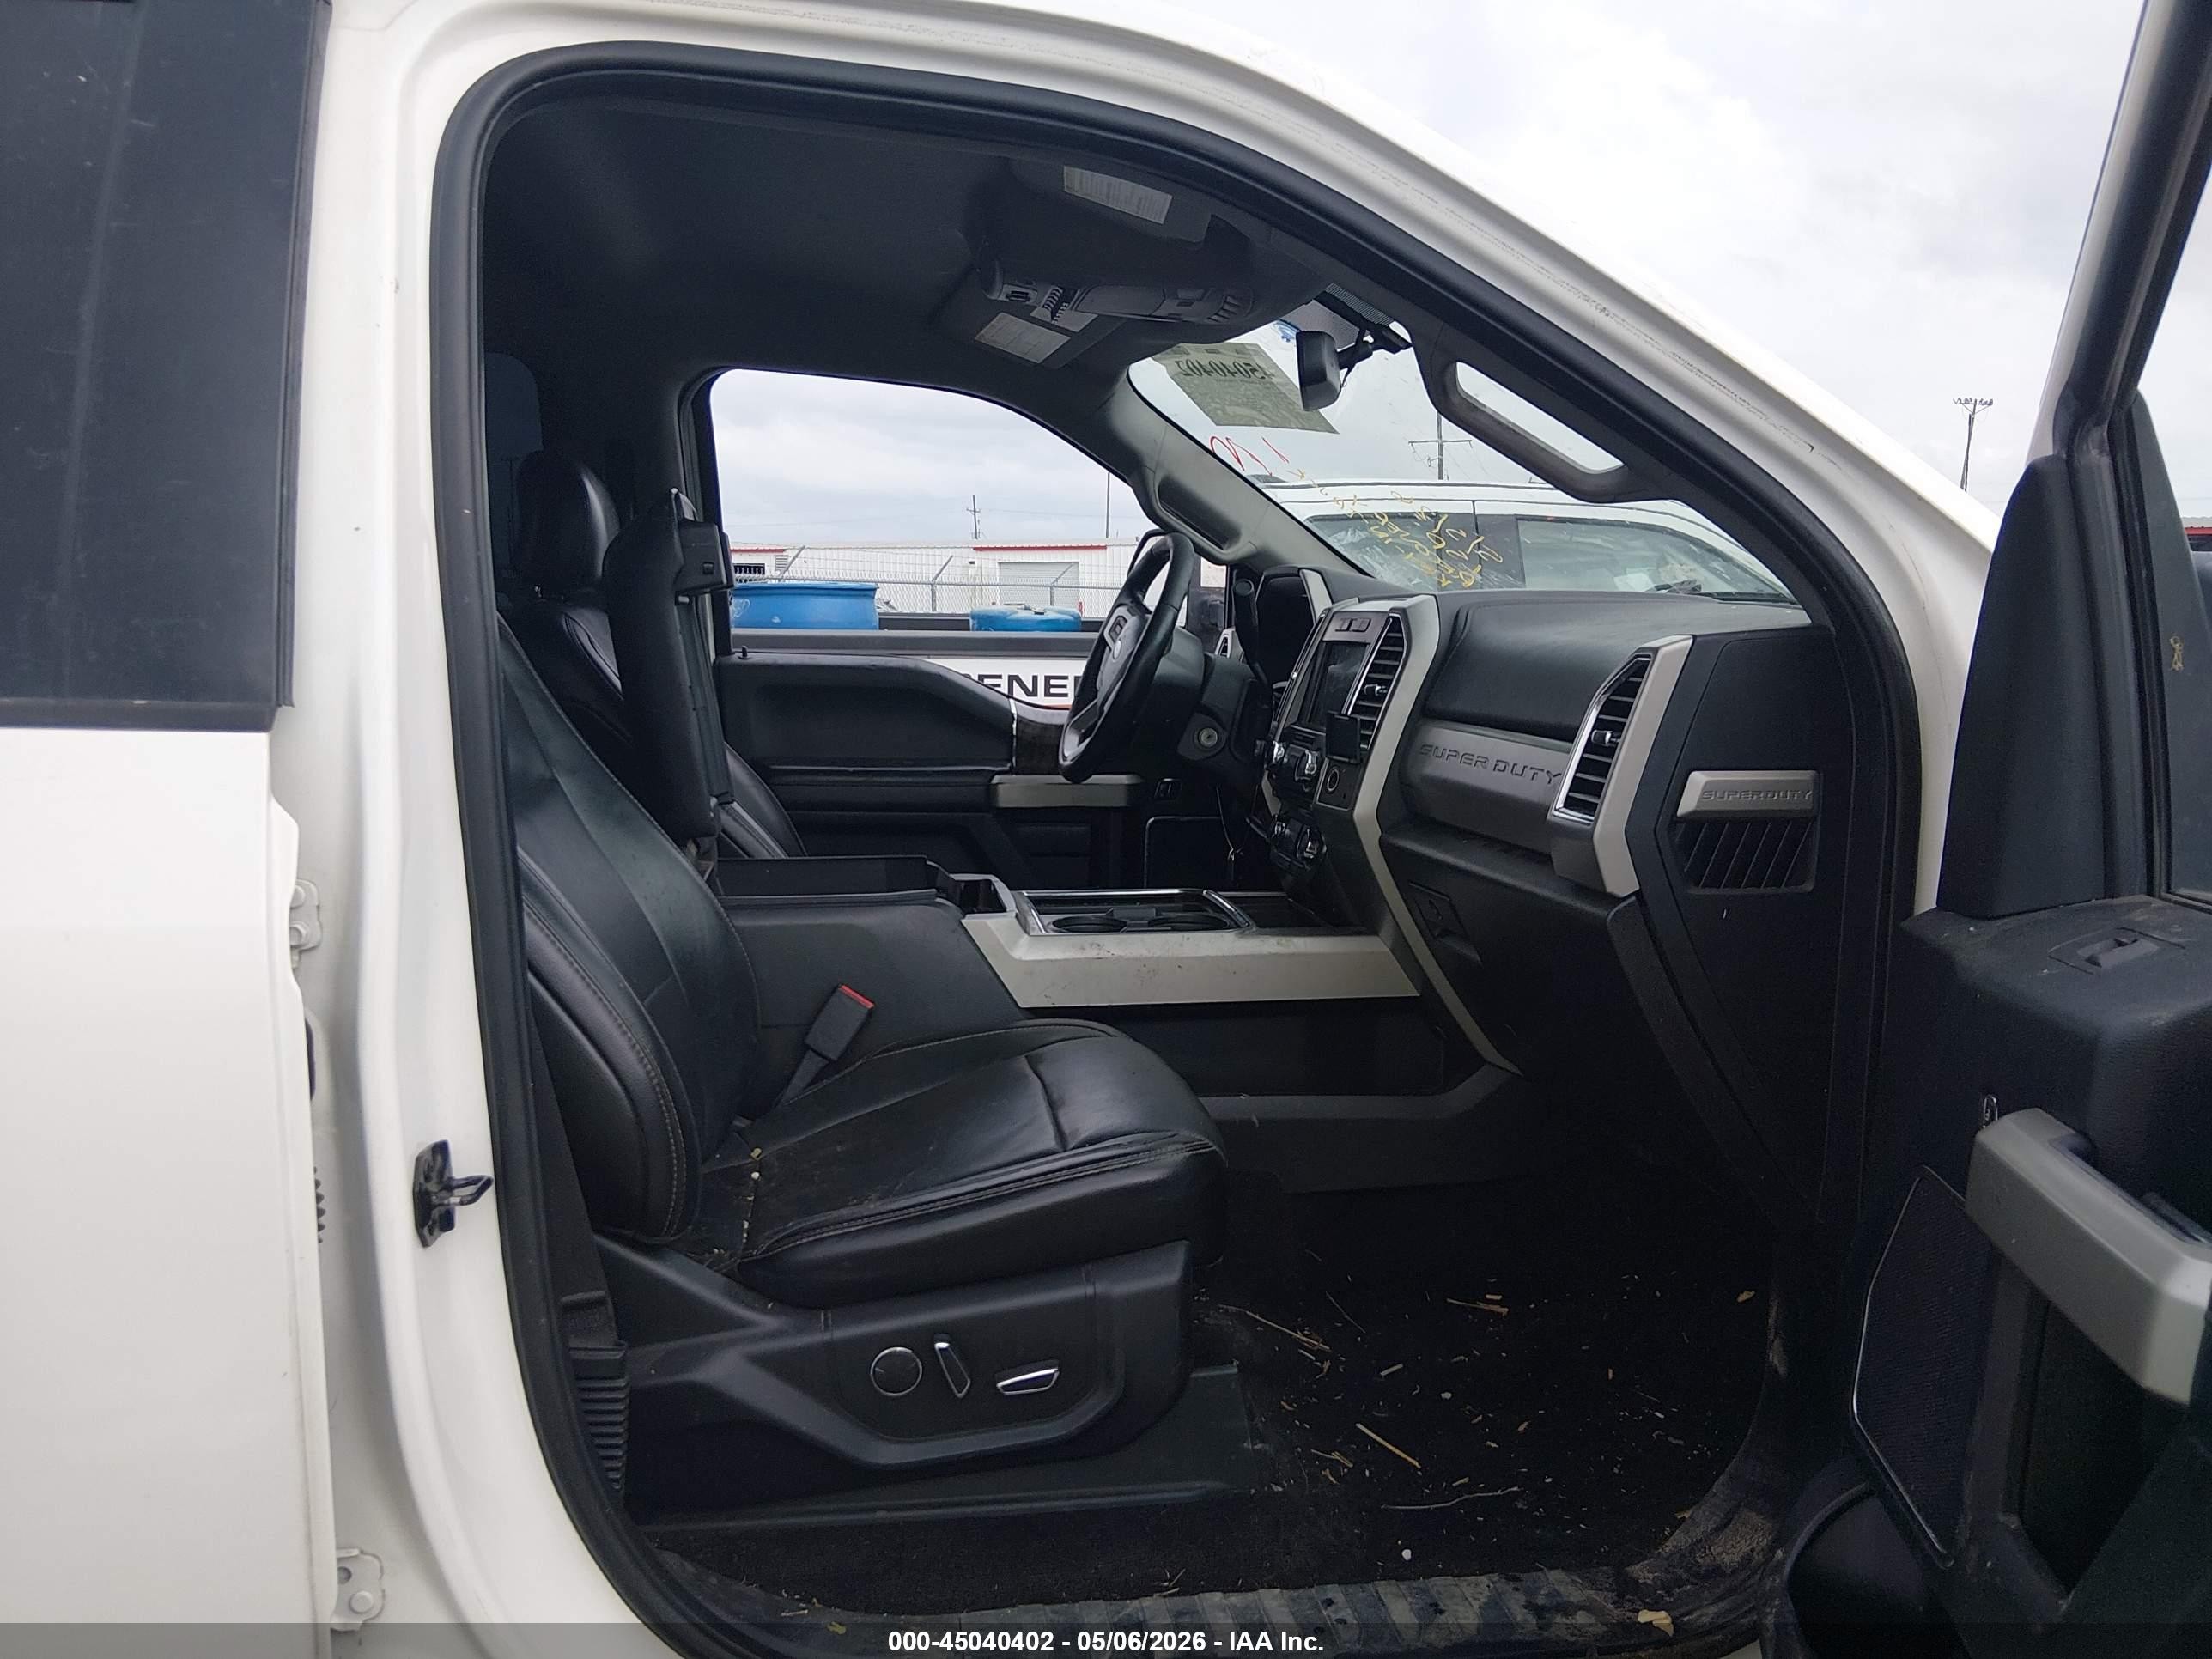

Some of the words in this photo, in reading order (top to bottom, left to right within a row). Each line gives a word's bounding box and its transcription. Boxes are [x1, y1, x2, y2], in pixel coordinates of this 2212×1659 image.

[962, 673, 1083, 698] ENE
[1419, 744, 1490, 769] SUPER
[1492, 759, 1562, 785] DUTY
